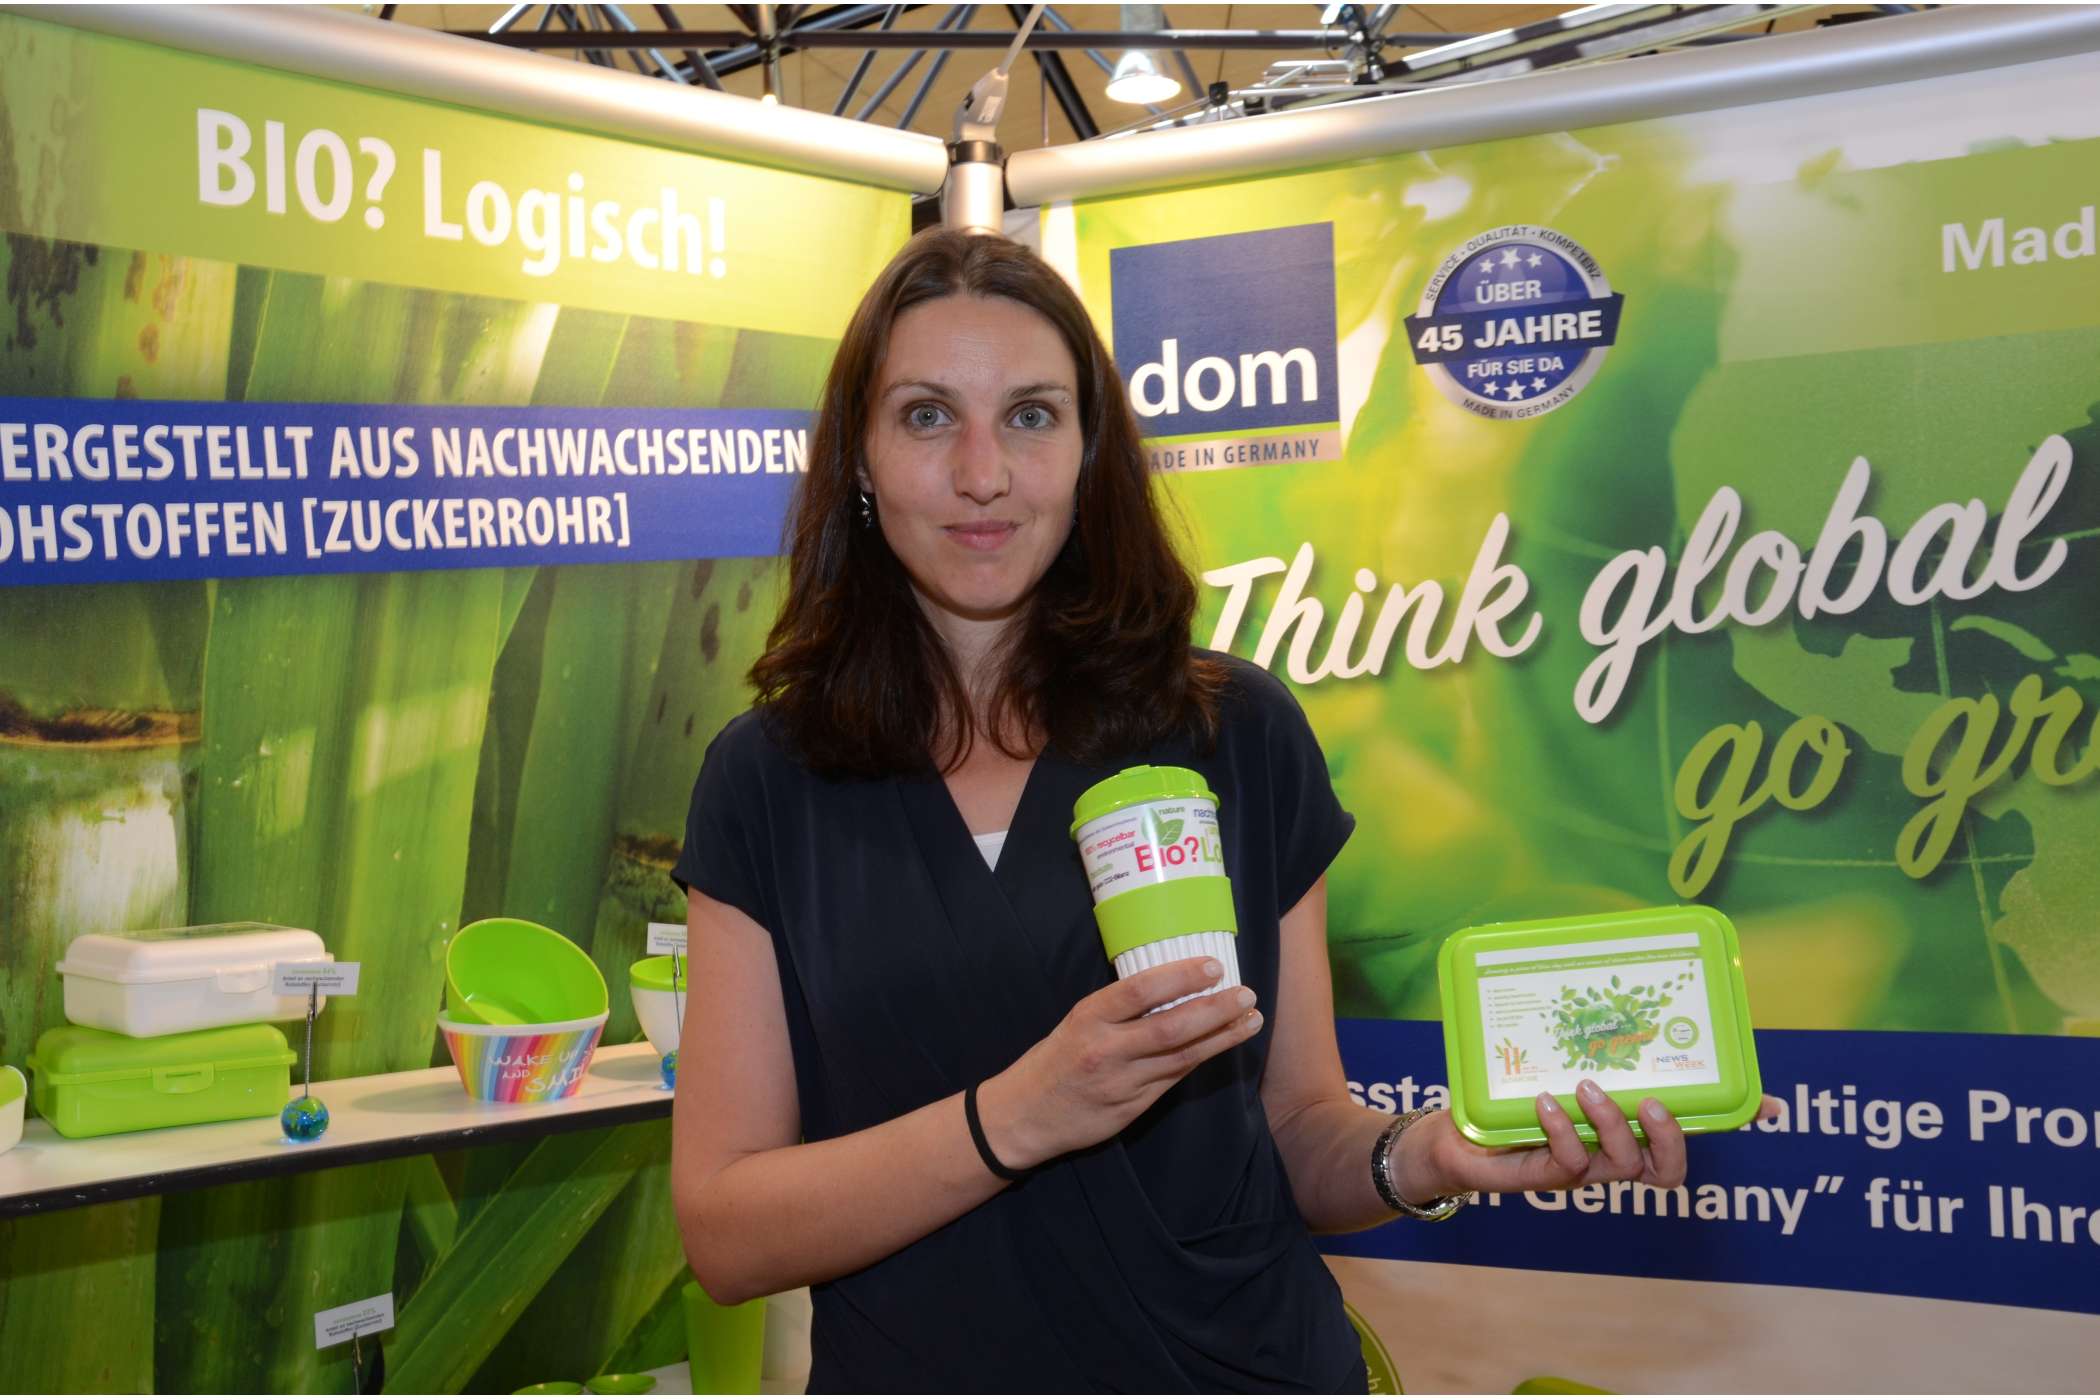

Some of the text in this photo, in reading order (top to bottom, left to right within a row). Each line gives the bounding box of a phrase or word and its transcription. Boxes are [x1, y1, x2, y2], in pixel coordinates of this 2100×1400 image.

[197, 107, 728, 279] BIO? Logisch!
[1426, 253, 1460, 302] SERVICE
[1537, 228, 1603, 281] KOMPETENZ
[1474, 279, 1543, 305] ÜBER
[1416, 309, 1603, 353] 45 JAHRE
[1129, 337, 1320, 418] dom
[1466, 356, 1565, 379] FÜR SIE DA
[1463, 384, 1577, 420] MADE IN GERMANY
[330, 425, 420, 481] AUS
[431, 426, 811, 479] NACHWACHSENDEN
[1149, 438, 1321, 470] ADE IN GERMANY
[302, 492, 631, 560] [ZUCKERROHR]
[1202, 434, 2075, 724] Think global
[1666, 673, 2100, 900] go gr
[489, 1054, 553, 1067] WAKE
[502, 1068, 532, 1080] AND
[1655, 1054, 1689, 1064] NEWS
[1673, 1059, 1705, 1069] WEEK
[1739, 1083, 1945, 1150] altige
[1864, 1177, 1965, 1234] für
